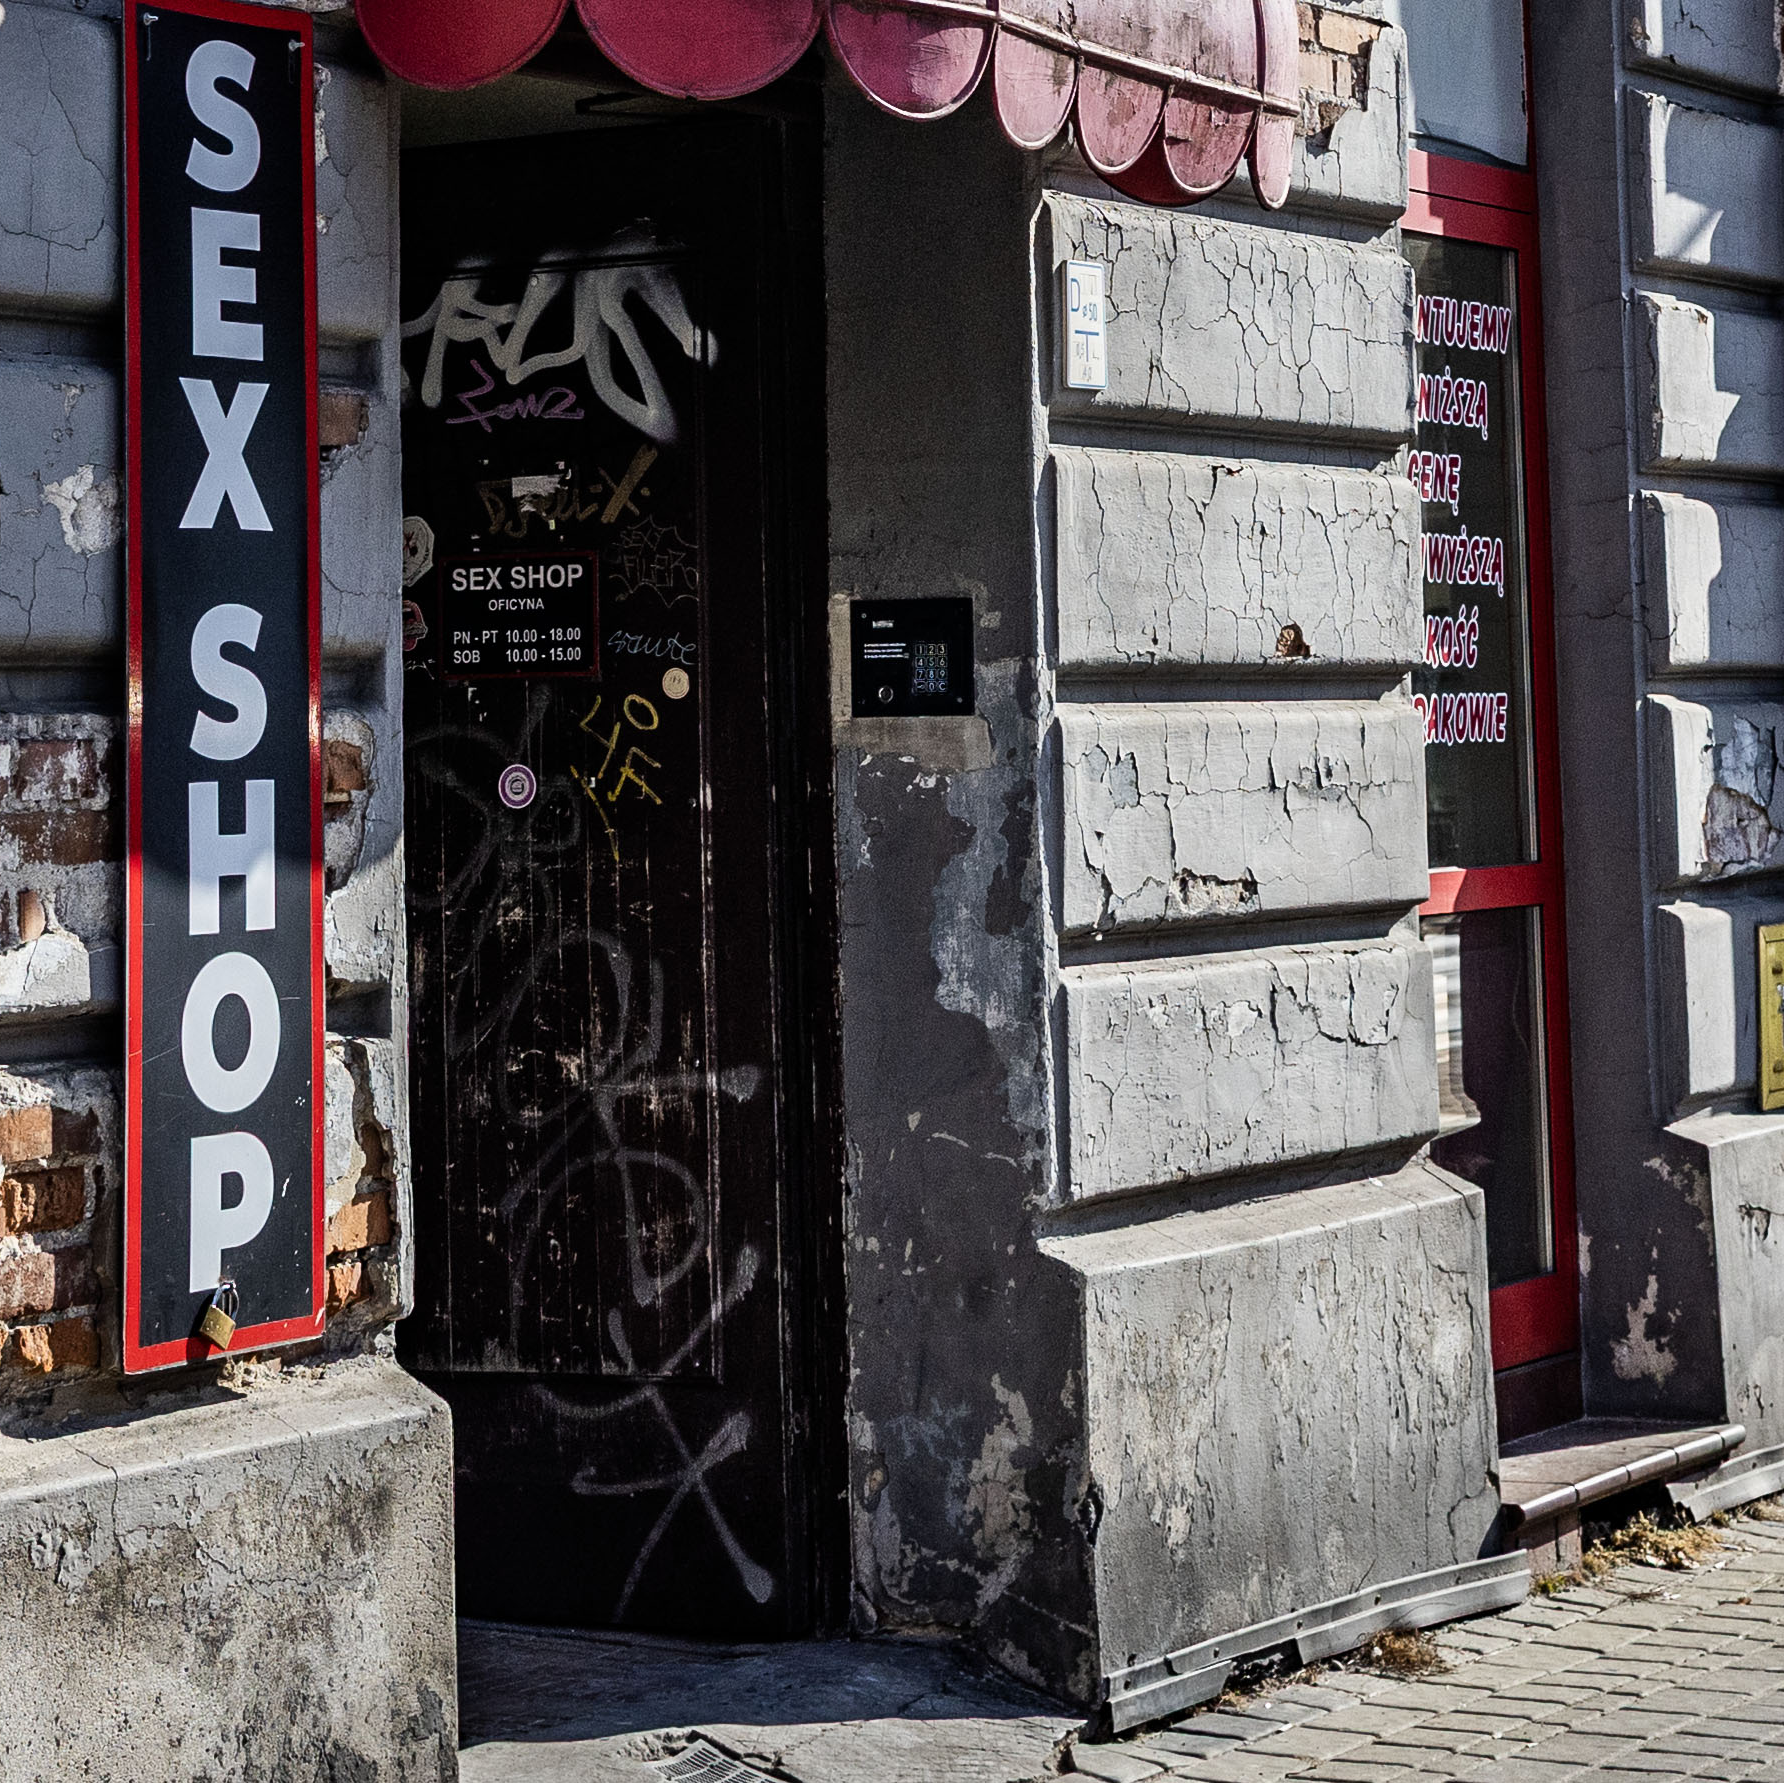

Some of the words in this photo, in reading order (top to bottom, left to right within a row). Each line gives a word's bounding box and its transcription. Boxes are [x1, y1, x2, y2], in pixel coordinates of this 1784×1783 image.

[178, 39, 274, 532] SEX
[1407, 449, 1461, 516] CENĘ
[452, 567, 503, 592] SEX
[510, 564, 583, 589] SHOP
[1421, 524, 1504, 597] WYŻSZĄ
[488, 598, 545, 611] OFICYNA
[453, 631, 471, 644] PN
[482, 630, 499, 643] PT
[506, 629, 538, 643] 10.00
[549, 627, 581, 641] 18.00
[453, 650, 481, 664] SOB
[506, 648, 538, 662] 10.00
[549, 647, 581, 661] 15.00
[1423, 604, 1479, 668] KOŚĆ
[1411, 692, 1508, 746] RAKOWIE
[181, 603, 280, 1291] SHOP
